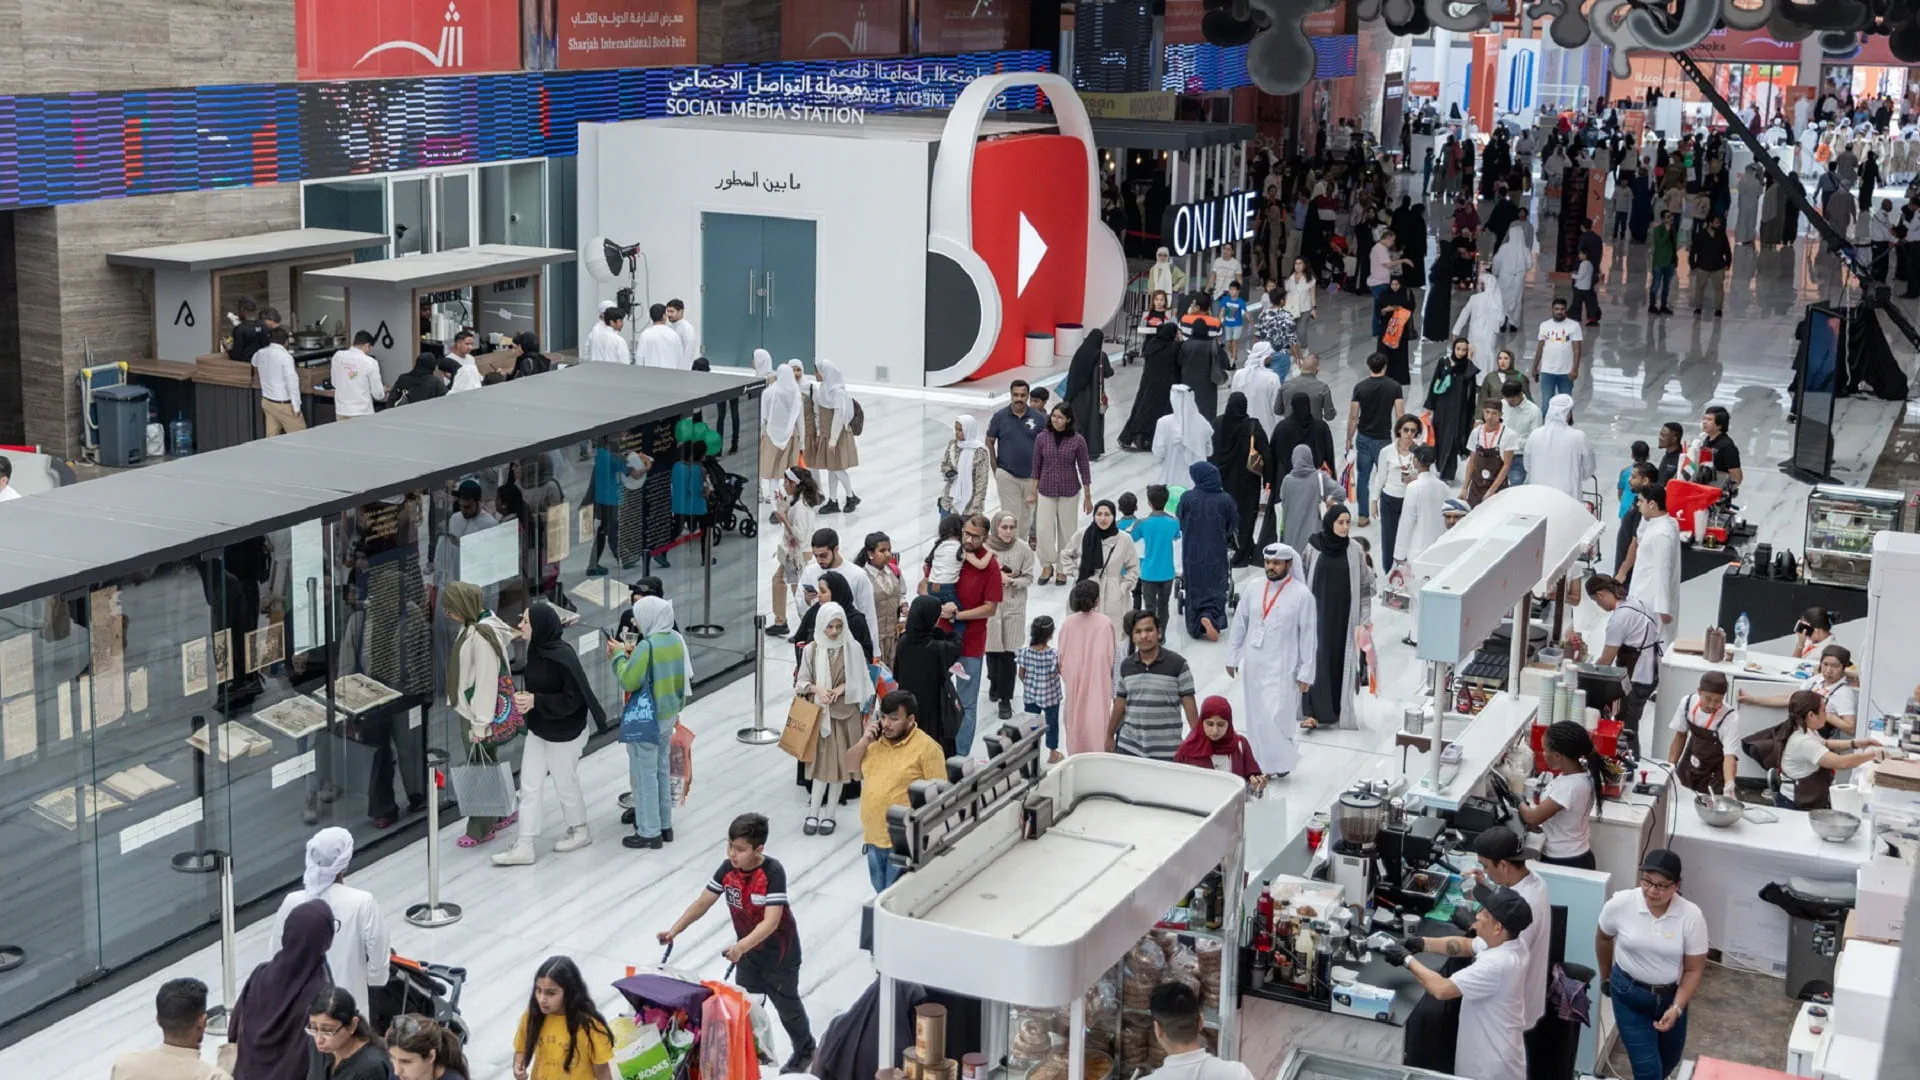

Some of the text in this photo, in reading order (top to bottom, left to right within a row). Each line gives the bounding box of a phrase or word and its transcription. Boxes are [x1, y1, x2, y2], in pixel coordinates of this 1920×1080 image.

[630, 11, 659, 28] الشارقة
[660, 13, 684, 27] معرض
[568, 34, 686, 53] Sharjah International Book Fair
[668, 69, 743, 97] الاجتماعي
[666, 98, 864, 124] SOCIAL MEDIA STATION
[714, 169, 759, 191] السطور
[1174, 192, 1257, 256] ONLINE
[427, 288, 462, 304] ORDER
